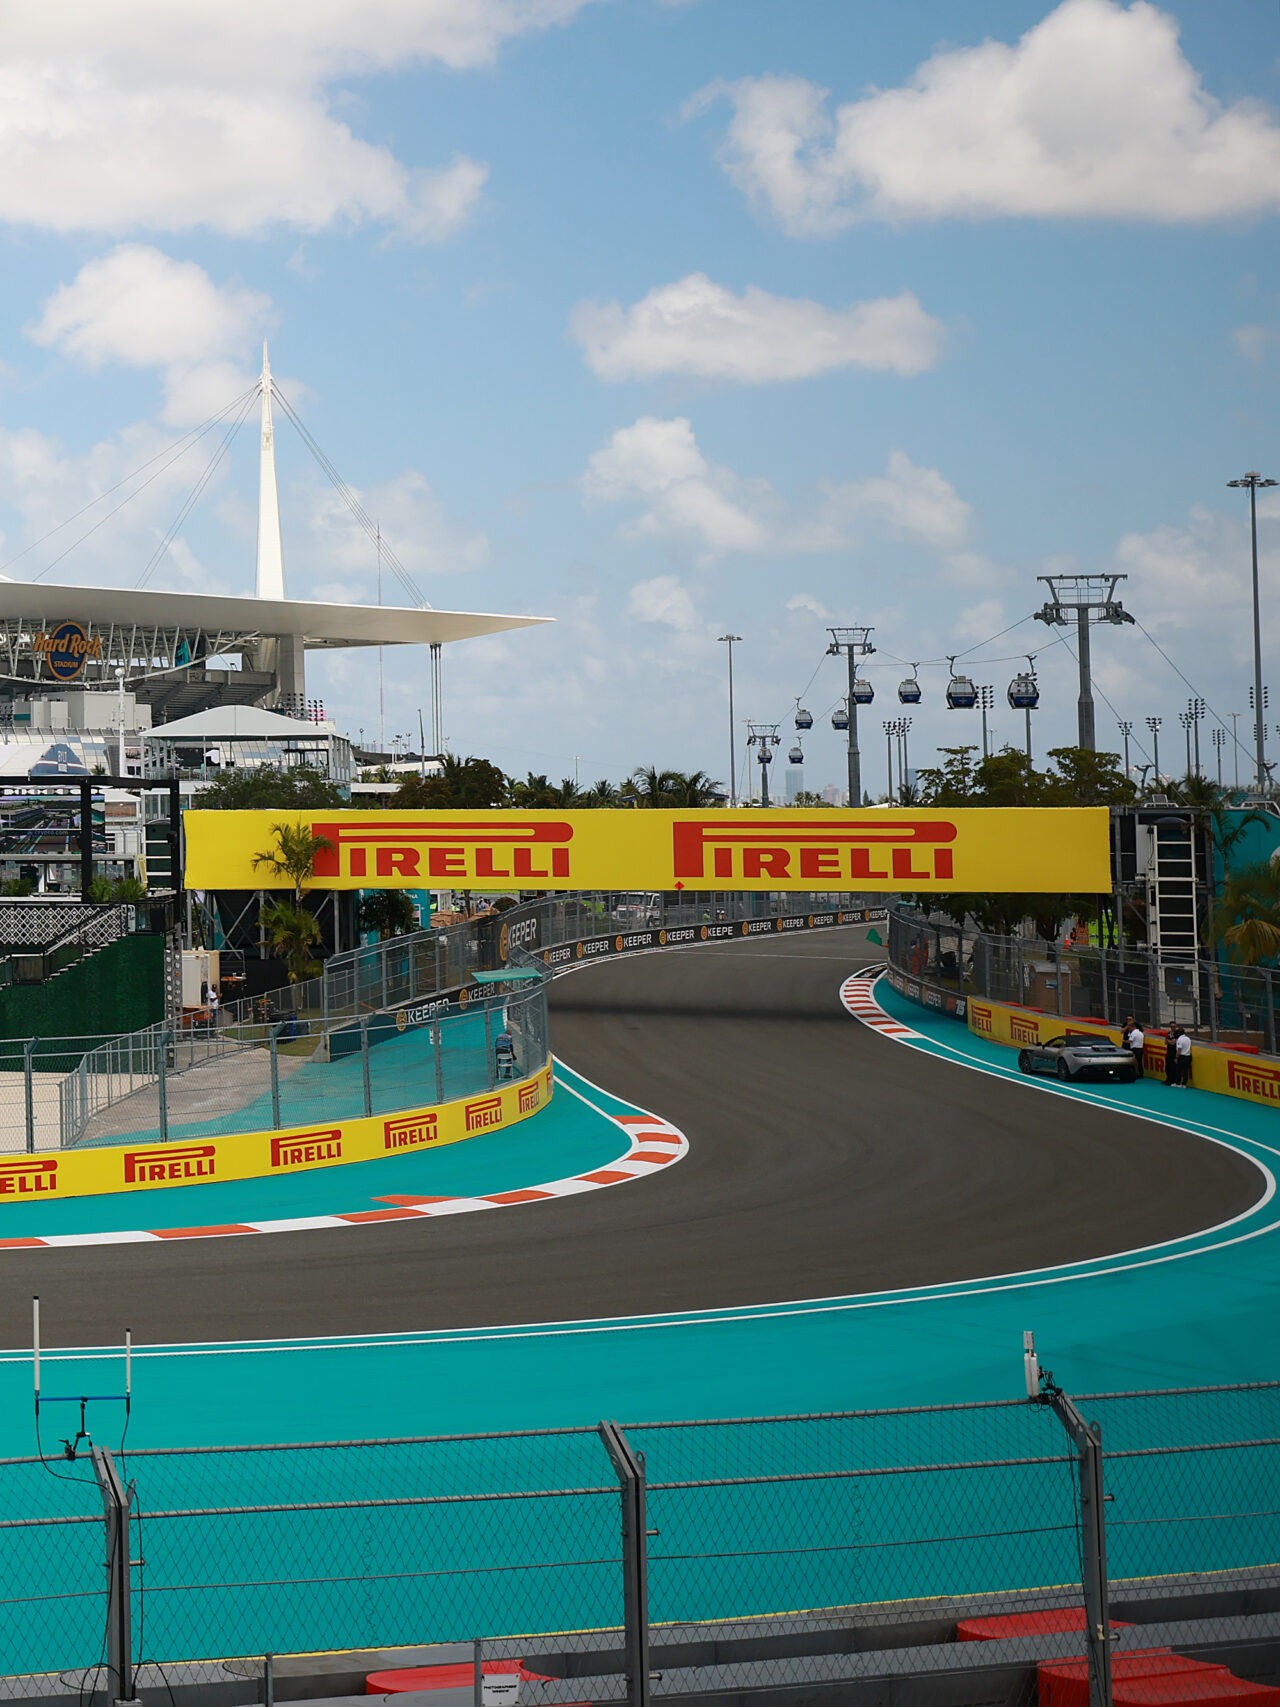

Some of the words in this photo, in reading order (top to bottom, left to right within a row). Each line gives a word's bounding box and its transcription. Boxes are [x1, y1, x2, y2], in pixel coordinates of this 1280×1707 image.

[33, 632, 70, 653] Hard
[69, 634, 102, 658] Rock
[311, 823, 573, 878] PIRELLI
[674, 822, 958, 879] PIRELLI
[748, 921, 772, 933] KEEPER
[782, 918, 804, 928] KEEPER
[813, 915, 834, 925] KEEPER
[842, 912, 861, 922] KEEPER
[508, 917, 537, 949] KEEPER
[623, 933, 652, 948] KEEPER
[666, 929, 695, 942] KEEPER
[549, 947, 571, 963] KEEPER
[582, 940, 609, 955] KEEPER
[1010, 1015, 1040, 1046] PIRELLI
[465, 1097, 502, 1131] PIRELLI
[384, 1113, 437, 1149] PIRELLI
[271, 1129, 342, 1166] PIRELLI
[124, 1145, 215, 1182] PIRELLI
